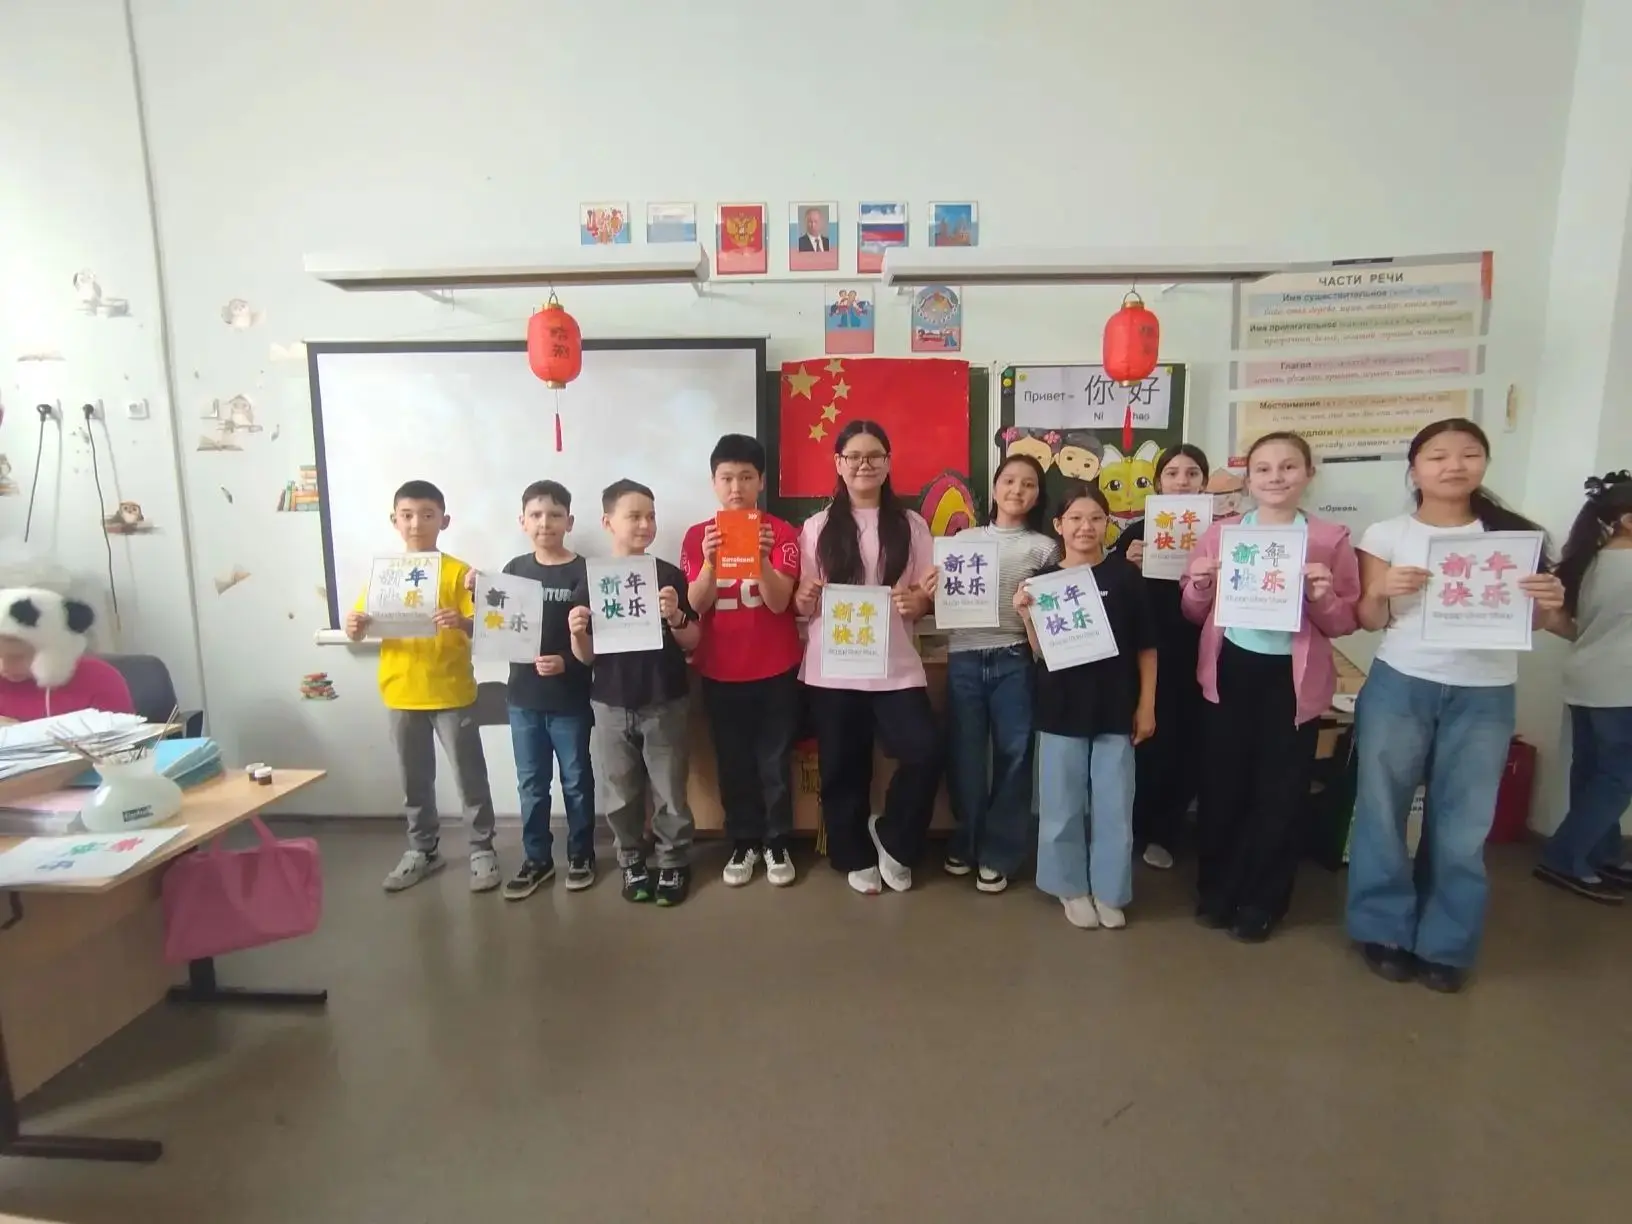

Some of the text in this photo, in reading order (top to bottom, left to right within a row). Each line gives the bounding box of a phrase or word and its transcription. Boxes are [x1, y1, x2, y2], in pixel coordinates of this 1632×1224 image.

[1319, 272, 1404, 287] ЧАСТИ РЕЧИ
[1024, 390, 1066, 404] Привет
[943, 552, 988, 574] 新年
[943, 576, 986, 597] 快乐
[601, 597, 647, 619] 快乐
